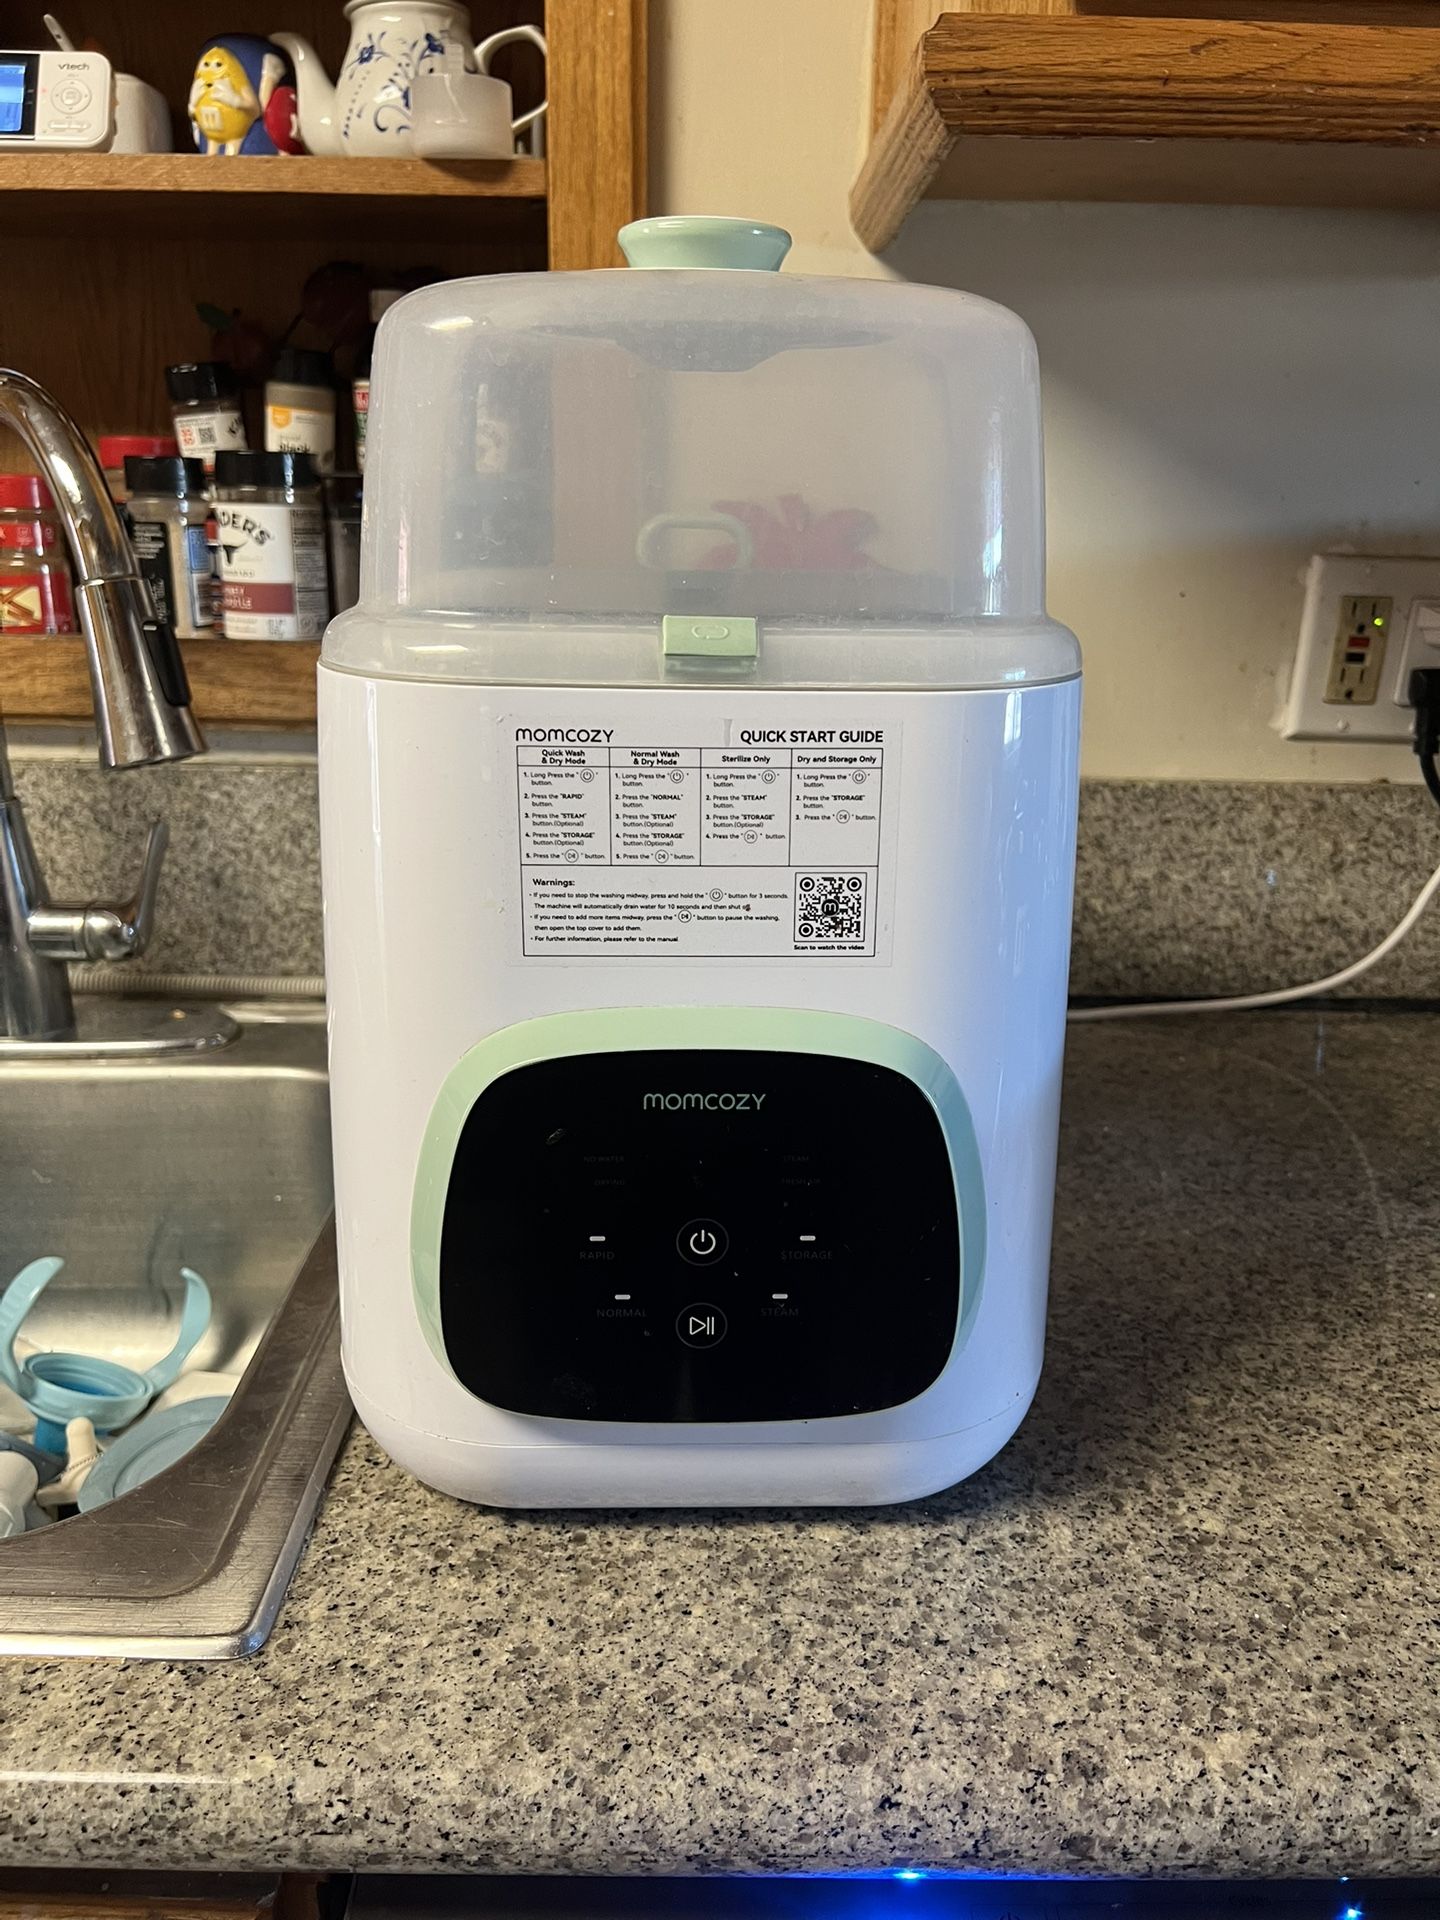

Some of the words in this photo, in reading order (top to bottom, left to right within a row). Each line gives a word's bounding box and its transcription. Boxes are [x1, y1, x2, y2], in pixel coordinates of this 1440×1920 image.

[217, 509, 272, 546] DER'S
[740, 730, 786, 744] QUICK
[790, 730, 836, 742] START
[839, 730, 883, 742] GUIDE
[550, 758, 562, 766] Dry
[641, 758, 654, 767] Dry
[533, 879, 575, 887] Warnings:
[579, 1250, 615, 1261] RAPID
[780, 1250, 833, 1261] STORAGE
[596, 1308, 647, 1319] NORMAL
[760, 1307, 799, 1318] STEAM
